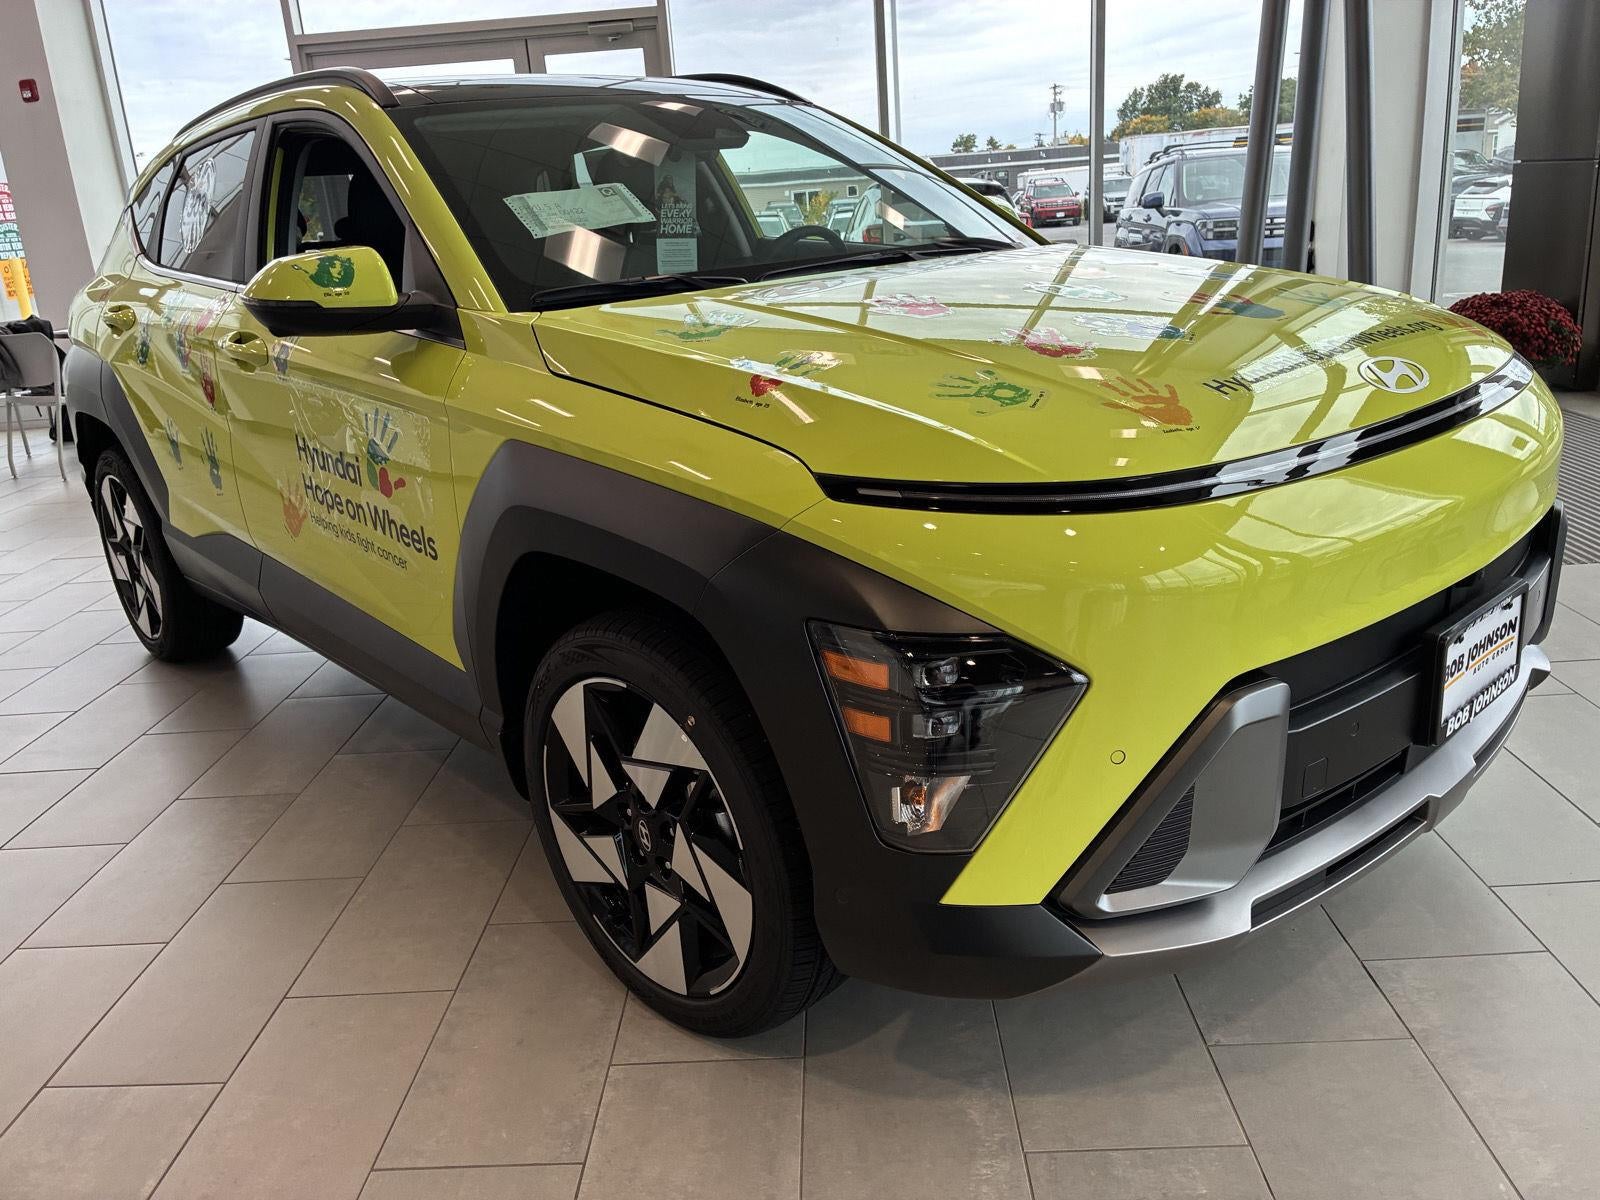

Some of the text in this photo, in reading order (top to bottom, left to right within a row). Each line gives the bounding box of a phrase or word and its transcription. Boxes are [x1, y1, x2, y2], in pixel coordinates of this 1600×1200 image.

[660, 224, 692, 234] HOME
[661, 209, 692, 218] EVERY
[295, 434, 362, 487] Hyundai
[301, 473, 438, 561] Hope on Wheels
[309, 510, 408, 570] Helping kids fight cancer
[1444, 616, 1518, 682] BOB JOHNSON
[1473, 641, 1514, 674] AUTO GROUP
[1446, 665, 1517, 737] BOB JOHNSON
